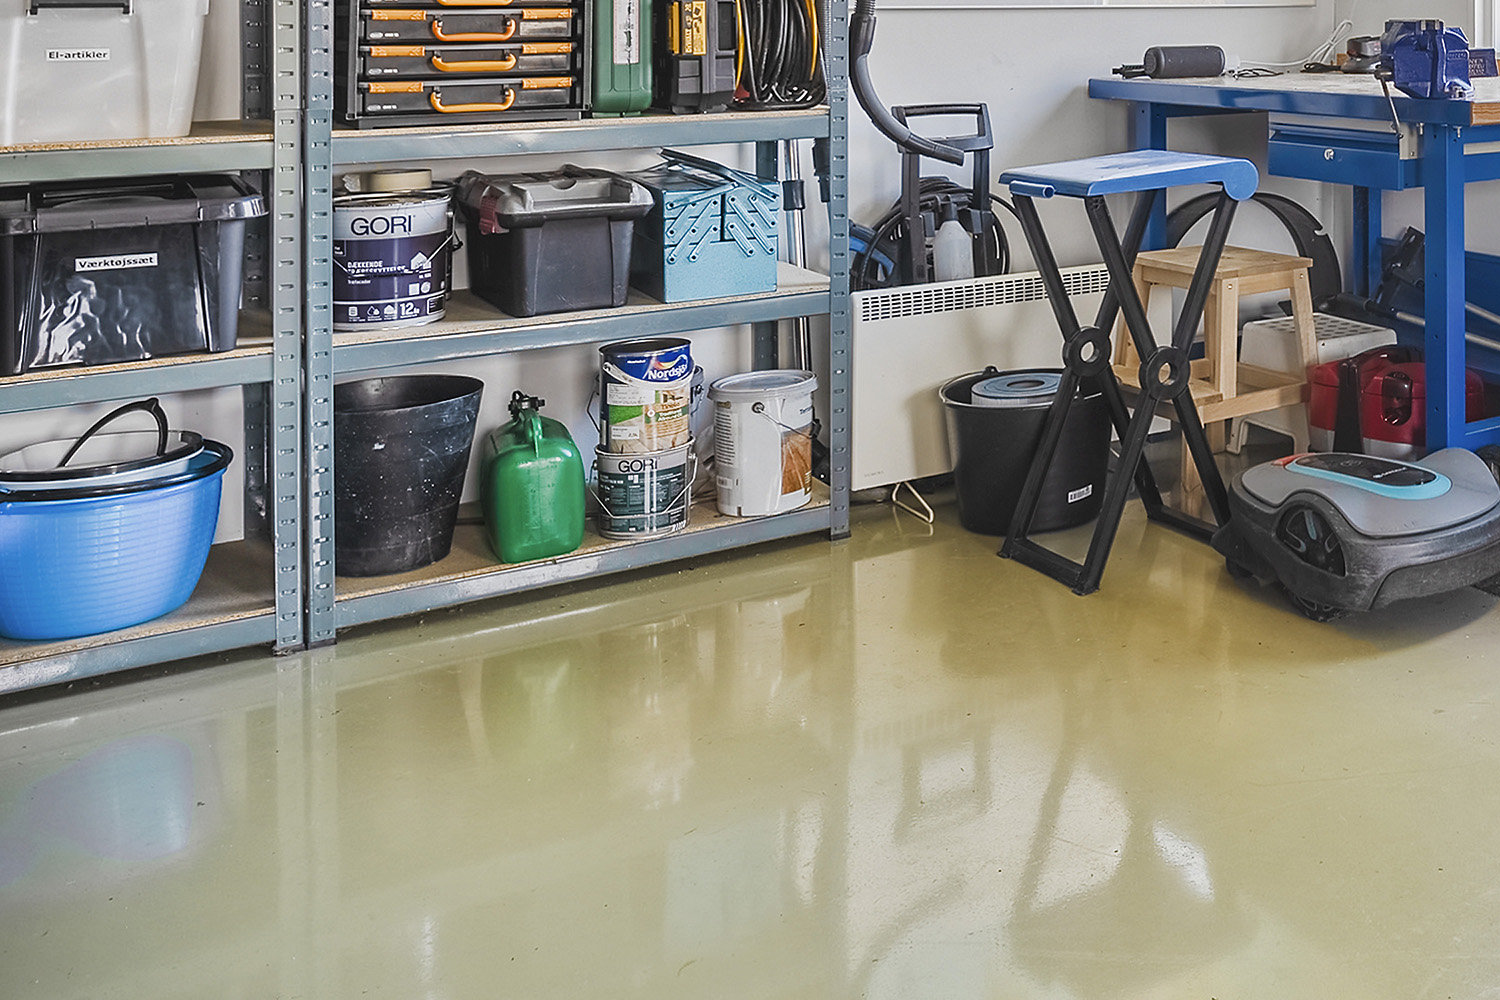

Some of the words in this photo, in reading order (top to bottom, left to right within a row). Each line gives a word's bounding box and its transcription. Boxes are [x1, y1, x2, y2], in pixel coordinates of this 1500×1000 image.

[48, 50, 108, 60] El-artikler
[350, 214, 412, 236] GORI
[77, 255, 155, 270] Værktøjssæt
[618, 457, 658, 473] GORI
